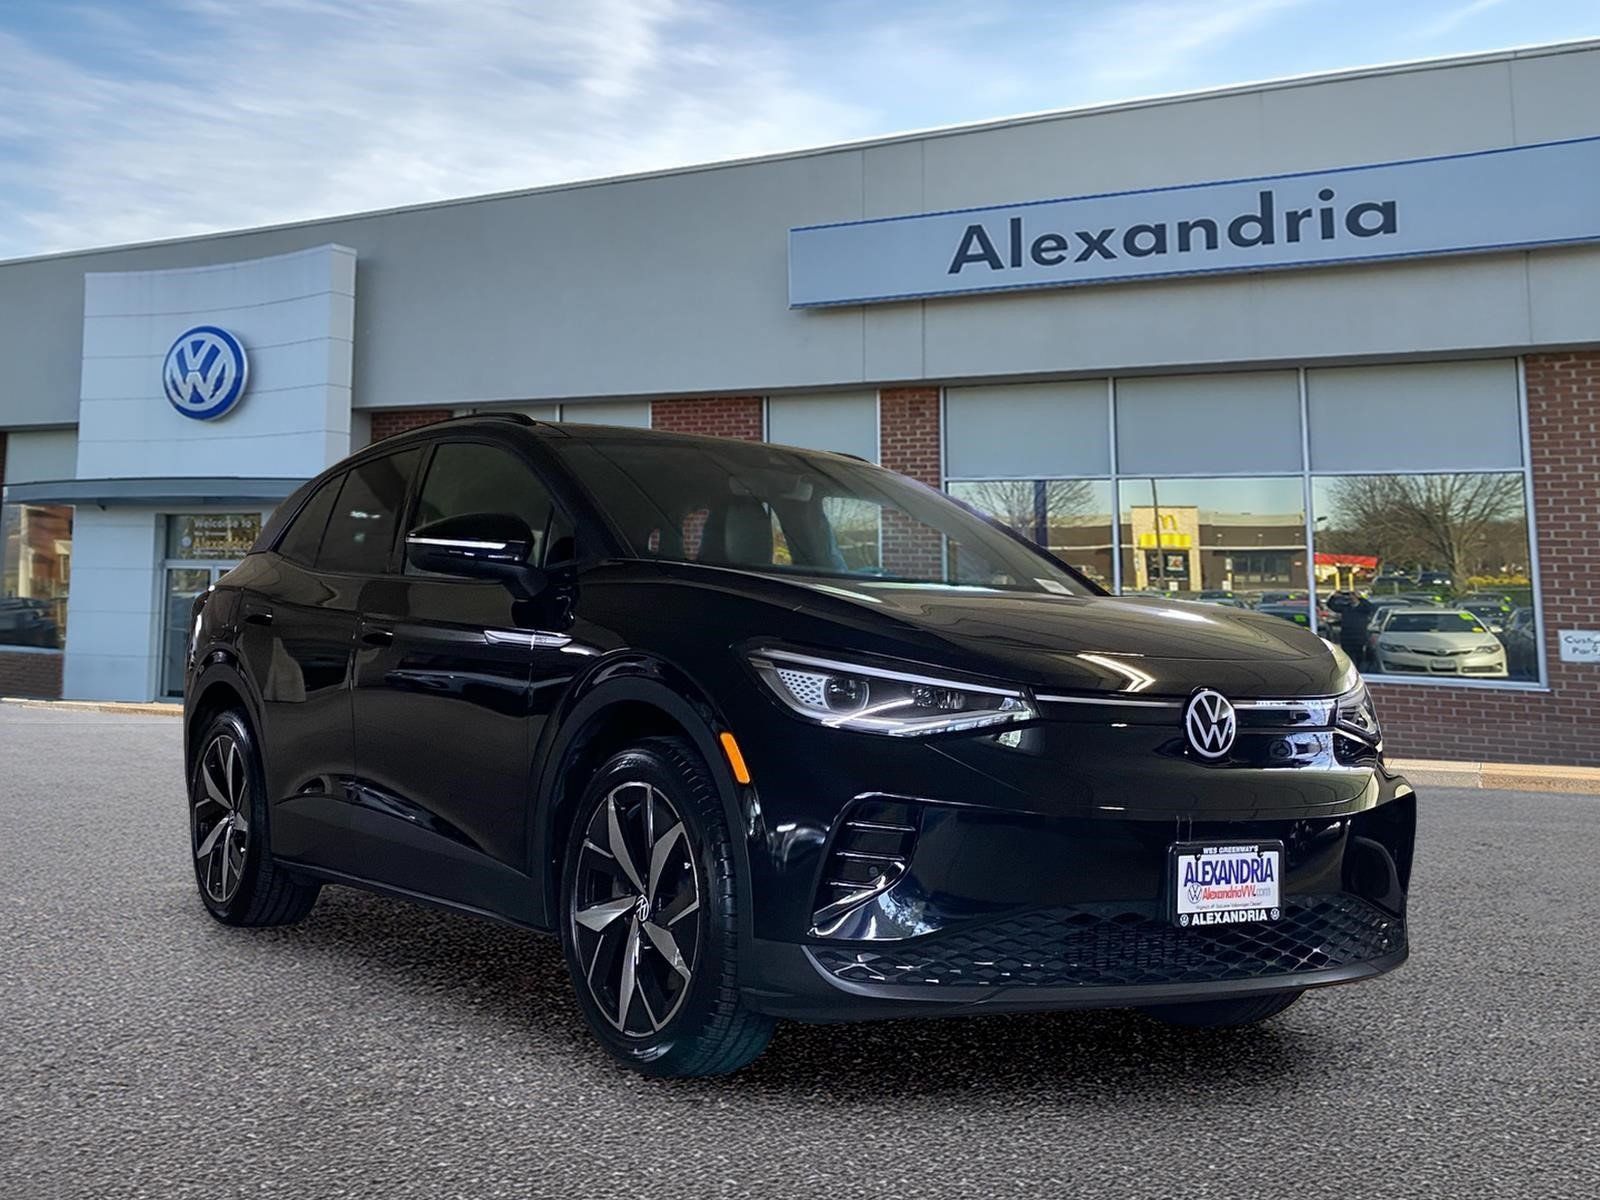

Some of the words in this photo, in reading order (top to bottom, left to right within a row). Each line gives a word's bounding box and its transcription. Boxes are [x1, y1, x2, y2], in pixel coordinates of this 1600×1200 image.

[947, 188, 1398, 274] Alexandria
[194, 519, 239, 528] Welcome
[1184, 858, 1274, 887] ALEXANDRIA
[1192, 909, 1267, 926] ALEXANDRIA
